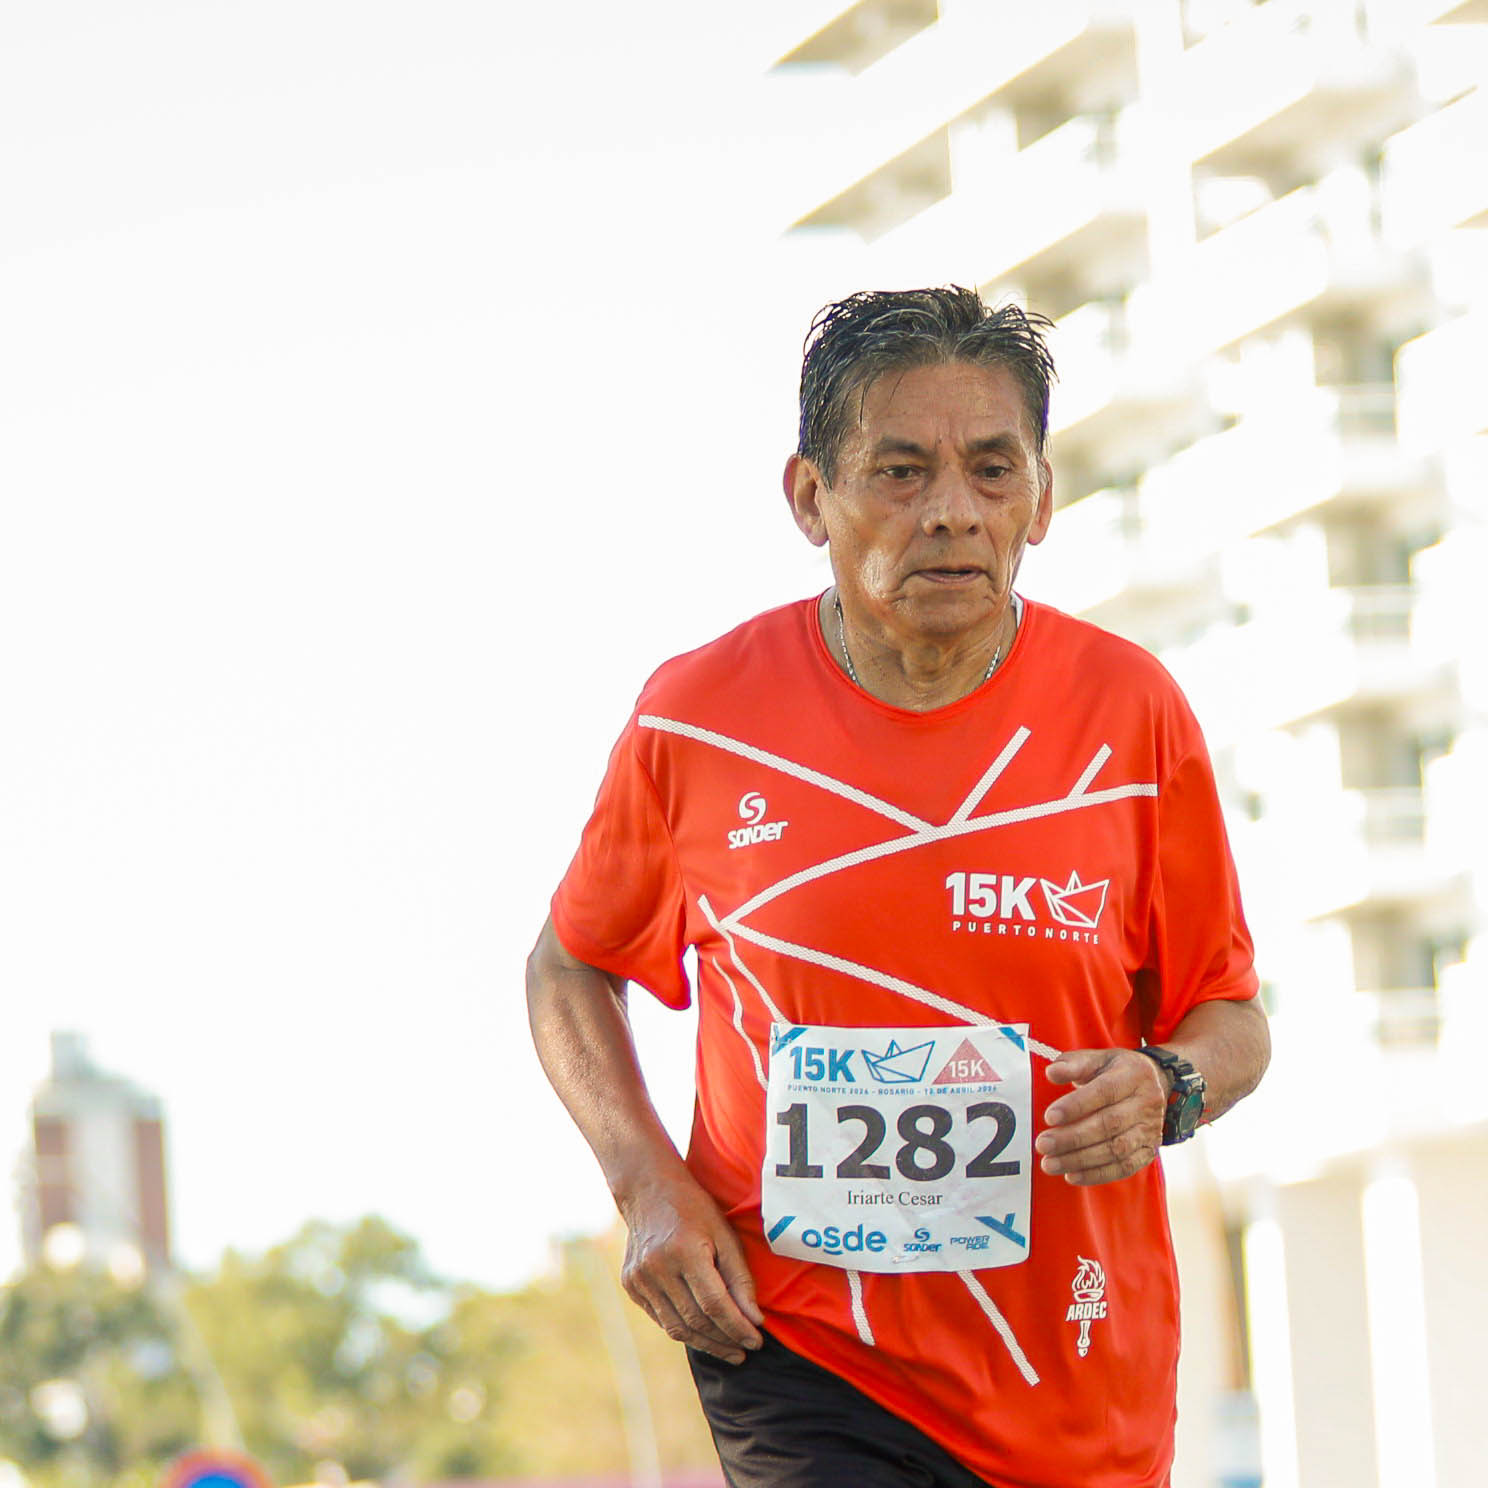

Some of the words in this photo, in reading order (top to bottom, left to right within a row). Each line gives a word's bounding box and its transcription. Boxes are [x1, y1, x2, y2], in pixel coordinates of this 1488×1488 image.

[945, 872, 1037, 921] 15K
[952, 921, 1036, 937] PUERTO
[1045, 928, 1099, 945] NORTE
[790, 1046, 856, 1082] 15K
[949, 1059, 985, 1078] 15K
[787, 1084, 818, 1093] PUERTO
[820, 1086, 846, 1095] NORTE
[878, 1087, 914, 1096] ROSARIO
[776, 1102, 1021, 1181] 1282
[847, 1190, 894, 1205] Iriarte
[898, 1191, 943, 1206] Cesar
[801, 1224, 887, 1253] osde
[1065, 1301, 1107, 1321] ARDEC
